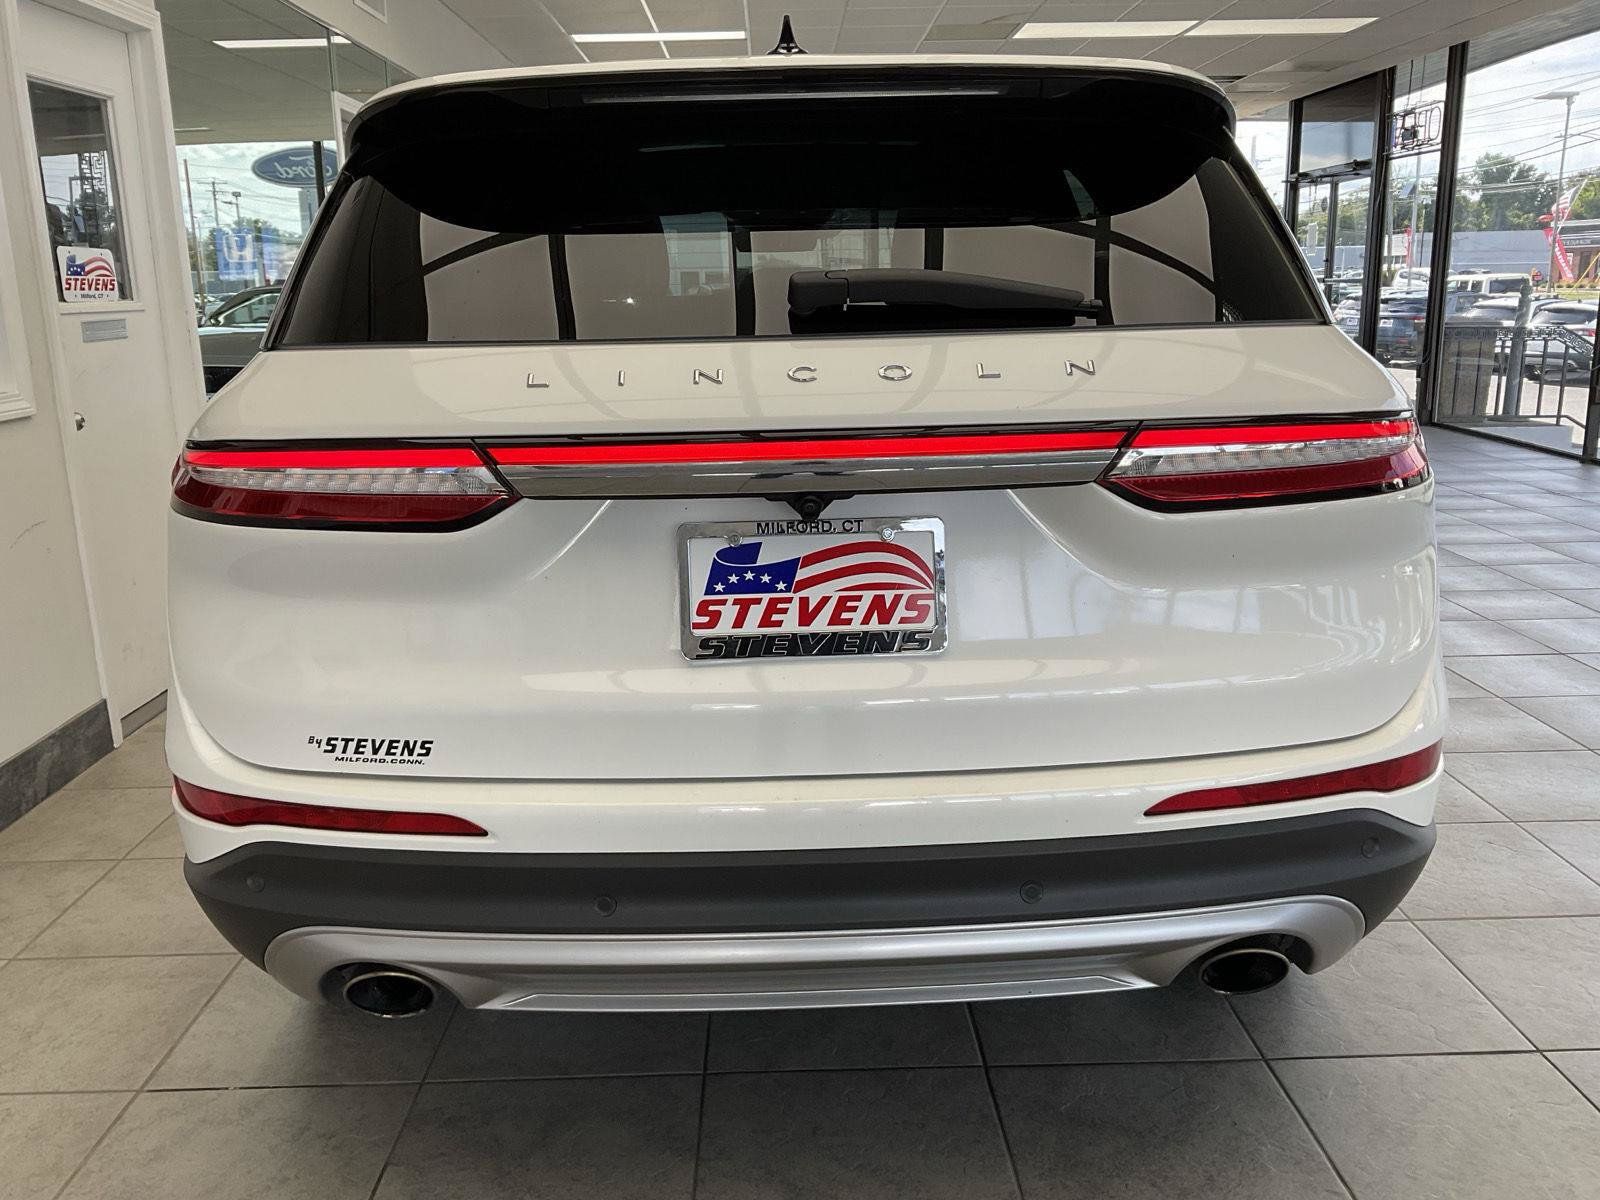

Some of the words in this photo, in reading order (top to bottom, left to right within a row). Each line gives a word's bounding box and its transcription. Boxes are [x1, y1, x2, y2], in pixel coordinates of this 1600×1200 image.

[64, 277, 116, 291] STEVENS
[525, 358, 1096, 390] LINCOLN
[756, 519, 838, 535] MILFORD,
[841, 519, 864, 533] CT
[691, 593, 936, 631] STEVENS
[696, 630, 934, 659] STEVENS
[307, 735, 322, 749] By
[322, 736, 434, 757] STEVENS
